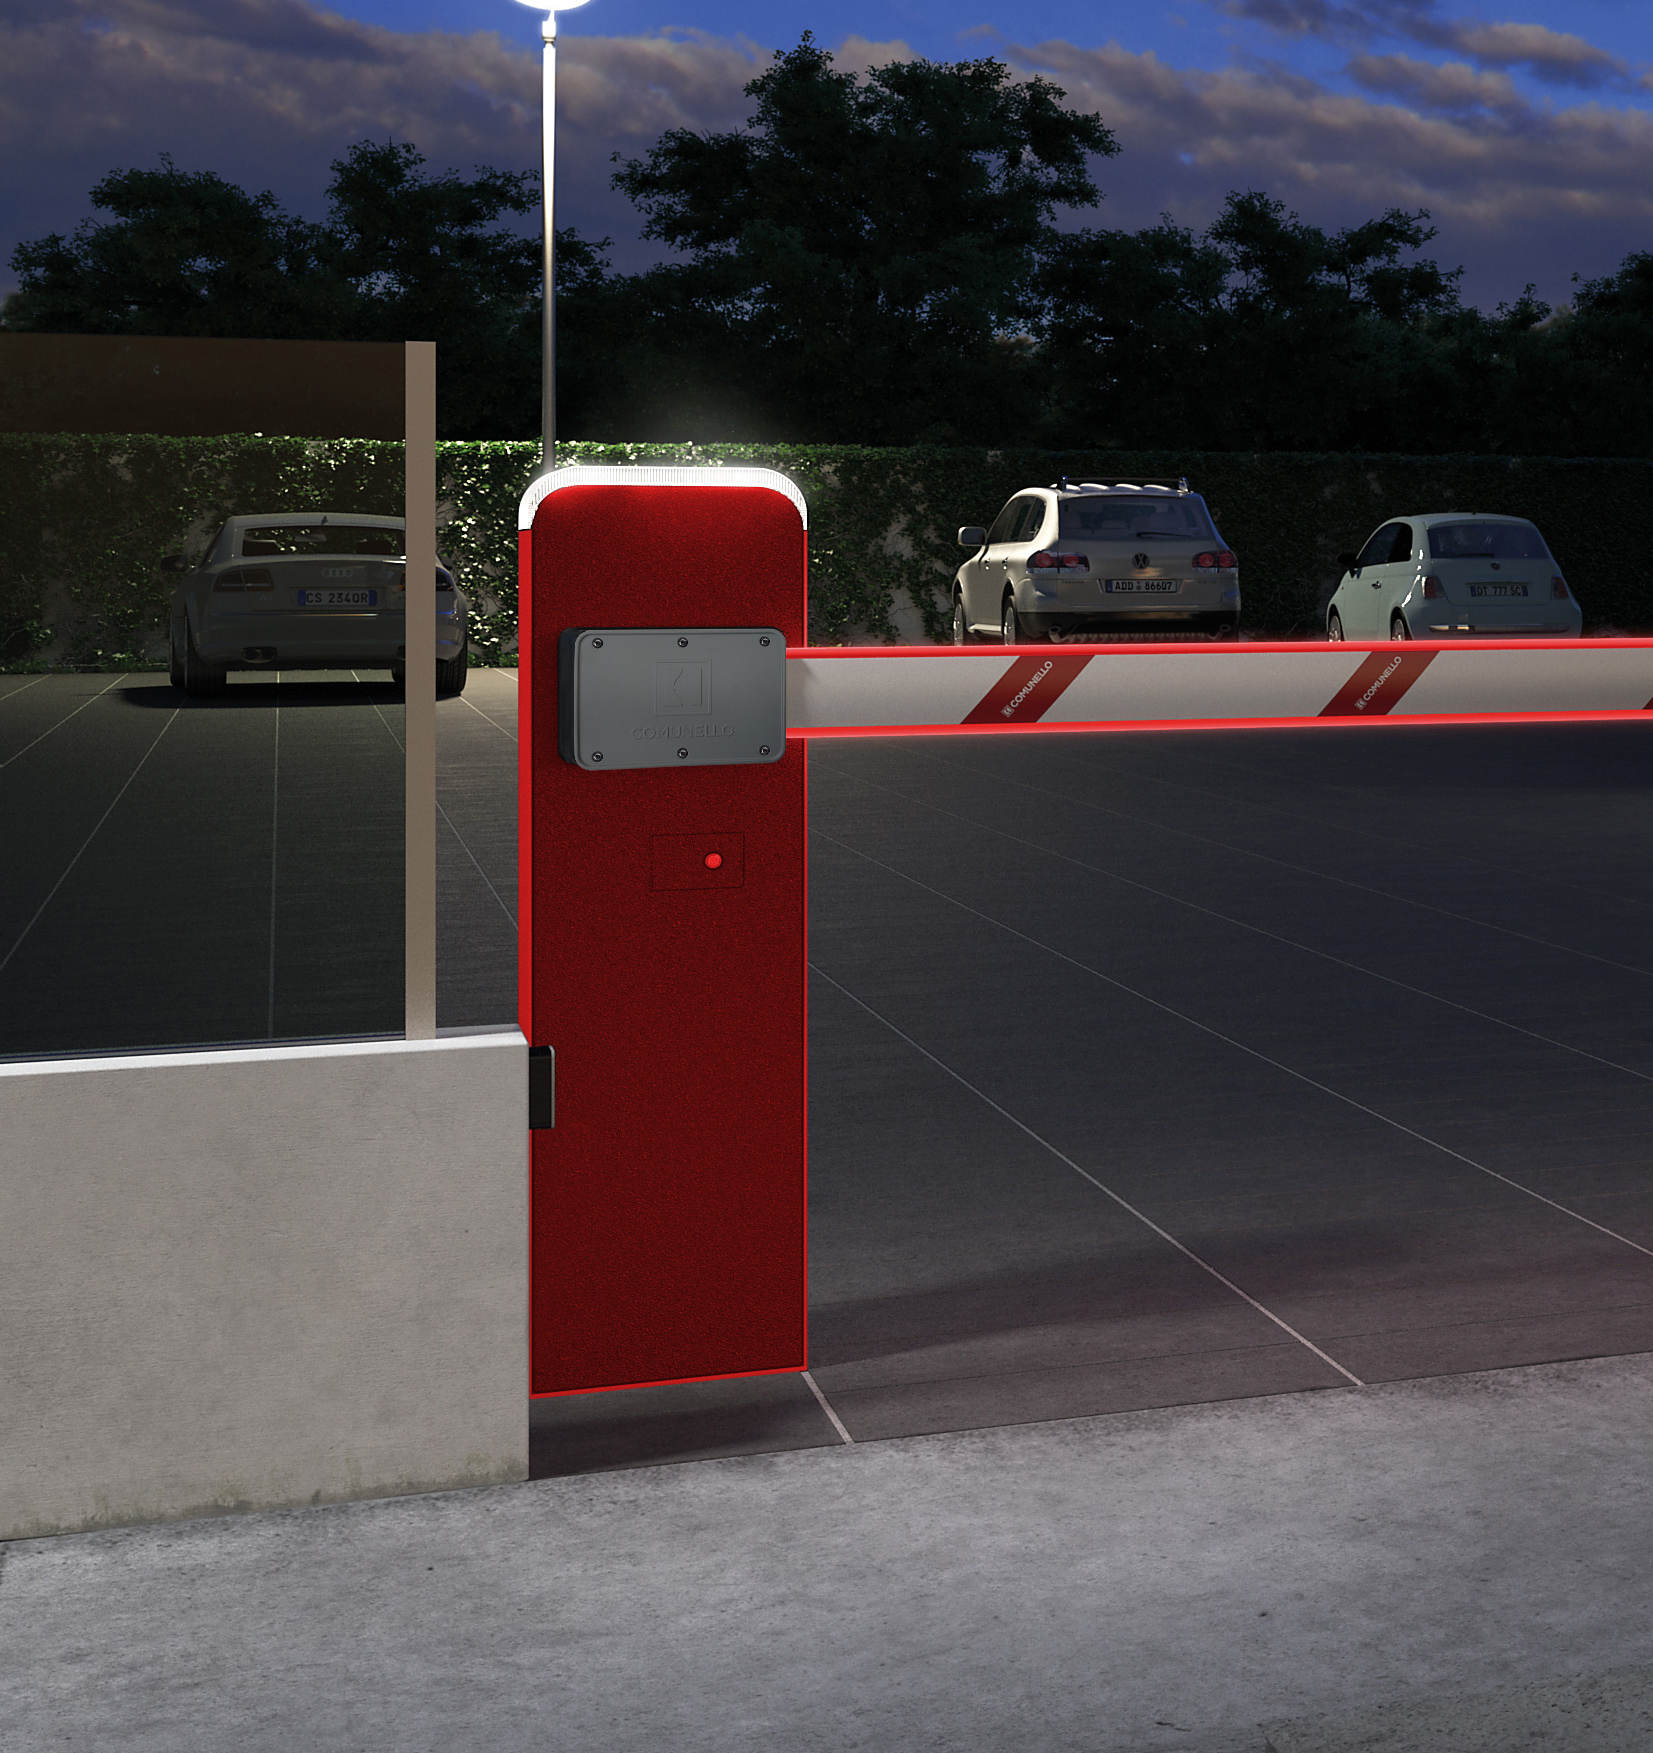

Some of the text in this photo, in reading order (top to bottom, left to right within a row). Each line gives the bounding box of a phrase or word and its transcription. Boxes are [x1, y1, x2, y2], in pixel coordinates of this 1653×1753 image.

[306, 592, 322, 604] CS
[1492, 587, 1507, 596] 777
[1010, 661, 1053, 708] COMUNELLO
[1363, 656, 1402, 702] COMUNELLO
[631, 723, 736, 740] COMUNELLO
